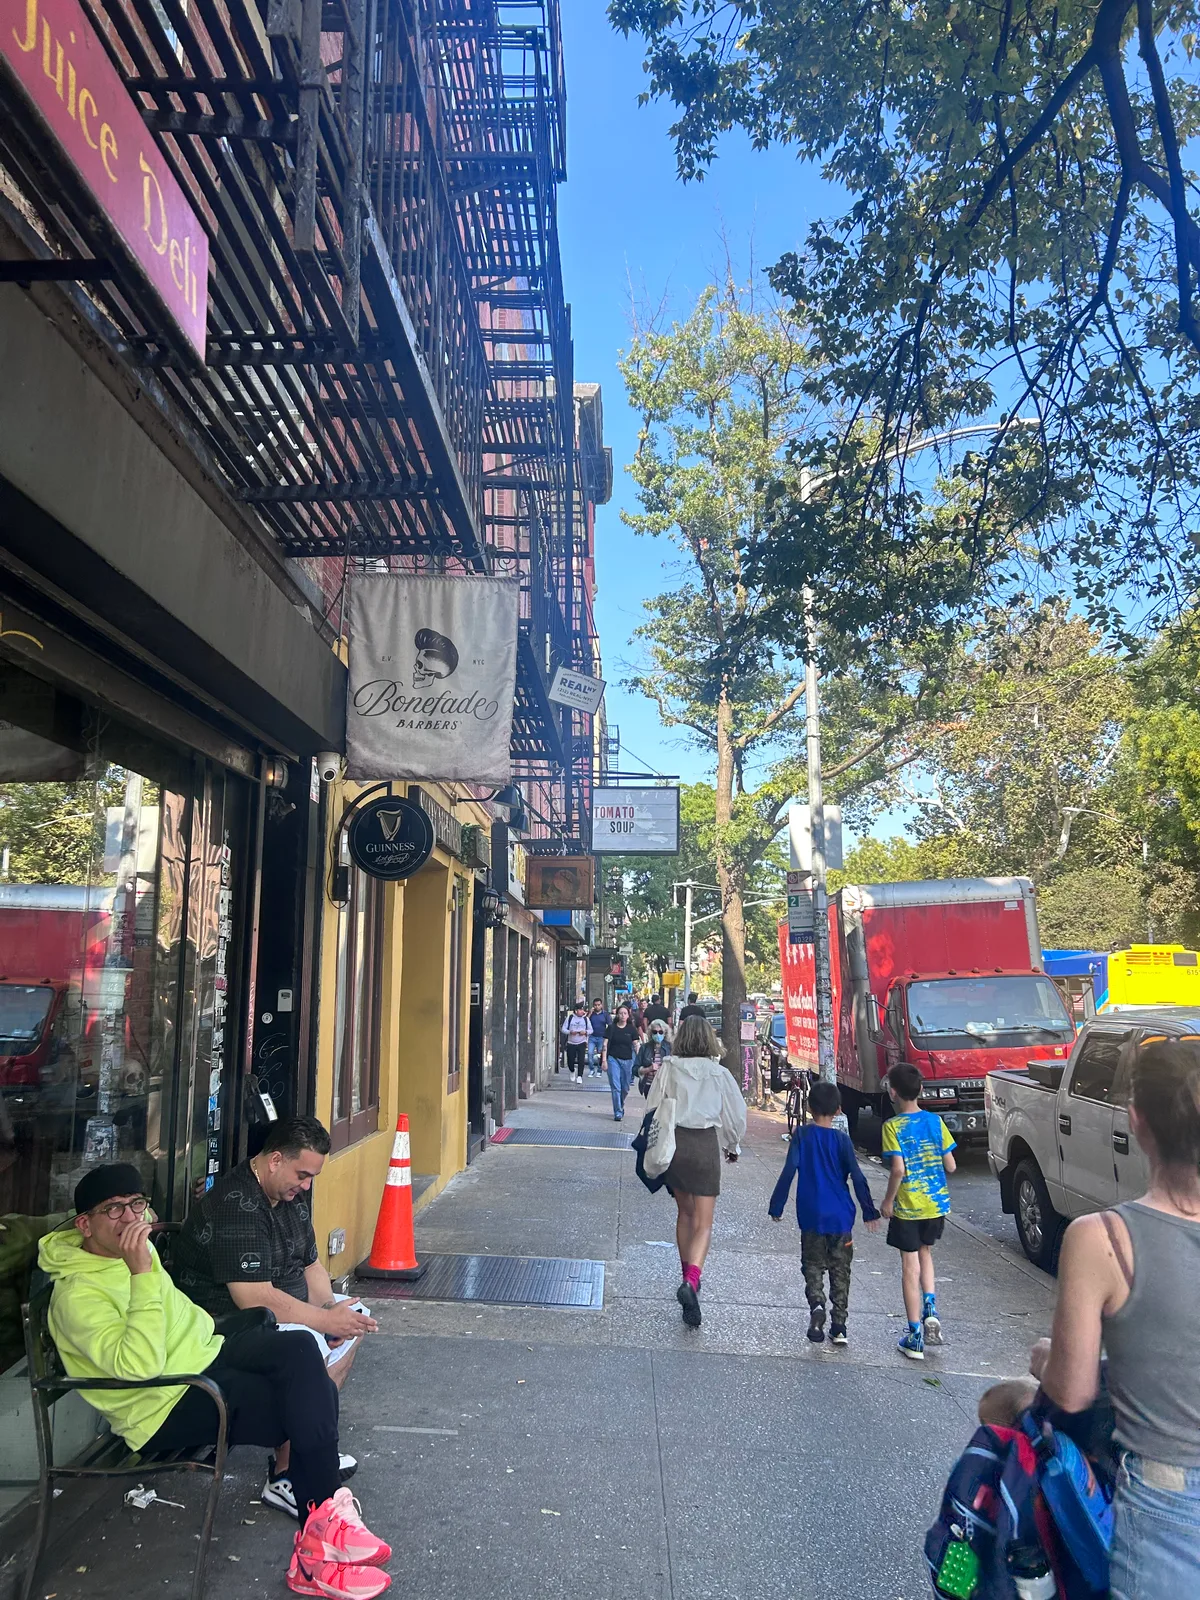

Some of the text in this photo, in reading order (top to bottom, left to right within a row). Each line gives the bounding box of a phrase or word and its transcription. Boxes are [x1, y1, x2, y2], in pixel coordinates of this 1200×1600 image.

[12, 0, 197, 317] Juice Deli
[353, 679, 499, 721] Bonefade
[594, 806, 634, 819] TOMATO
[610, 821, 635, 833] SOUP
[365, 842, 415, 853] GUINNESS
[790, 896, 796, 907] 2
[746, 1012, 753, 1020] P
[967, 1116, 977, 1130] 3
